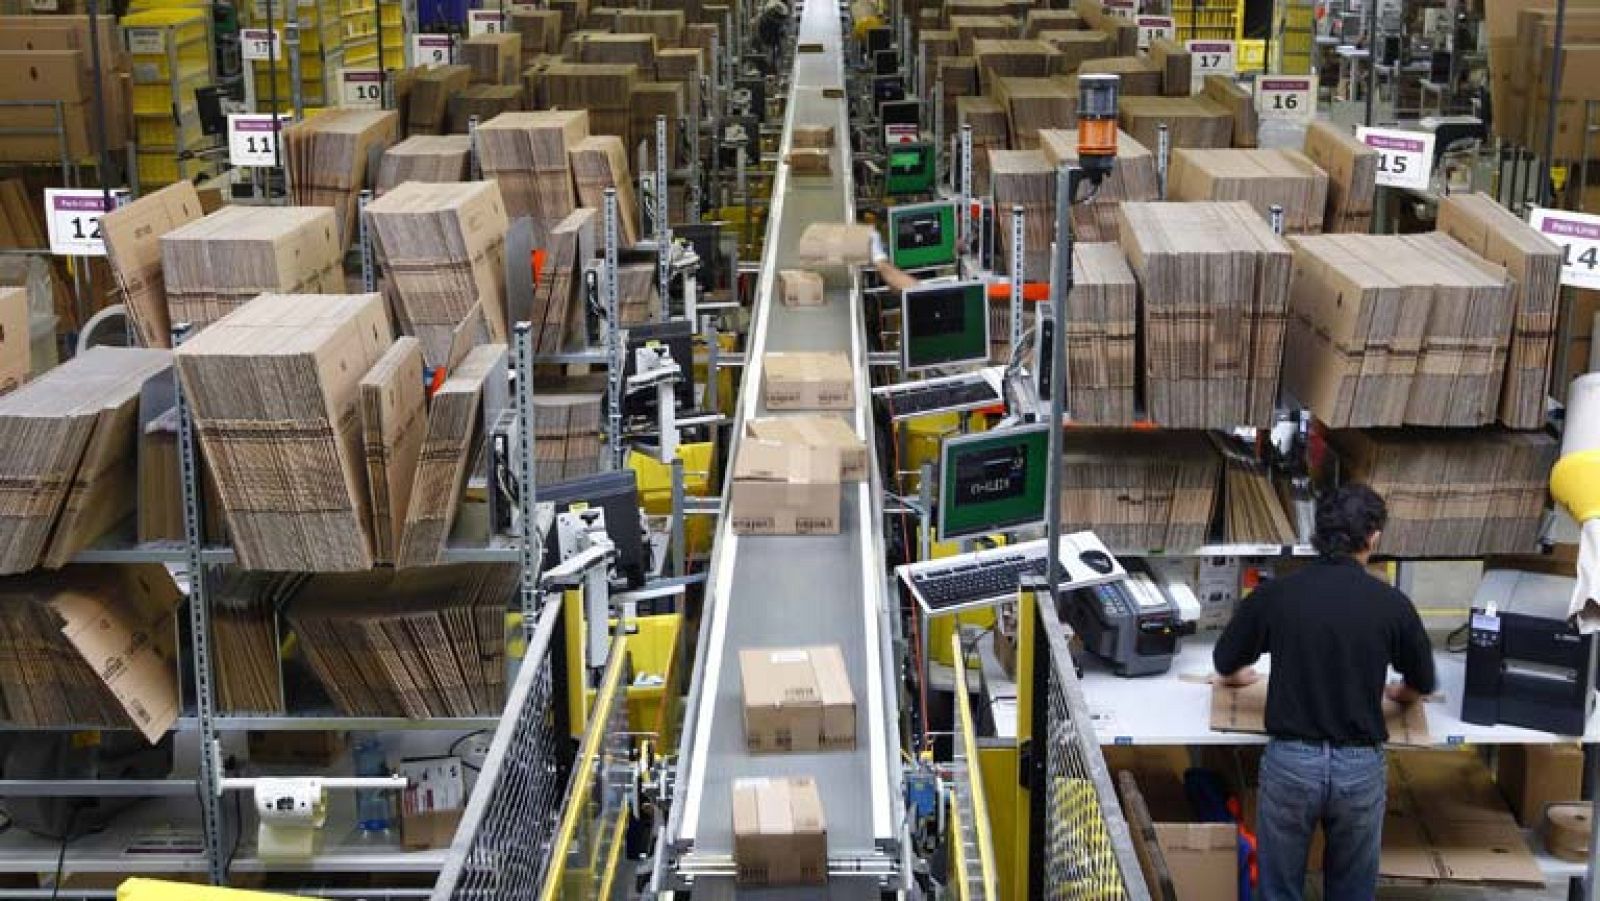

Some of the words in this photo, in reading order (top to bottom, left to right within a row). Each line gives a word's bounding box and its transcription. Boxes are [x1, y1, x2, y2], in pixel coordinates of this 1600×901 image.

[1200, 55, 1221, 68] 17
[356, 85, 380, 99] 10
[1272, 93, 1298, 109] 16
[246, 136, 272, 153] 11
[1377, 153, 1408, 174] 15
[70, 216, 102, 239] 12
[1560, 243, 1599, 270] 14
